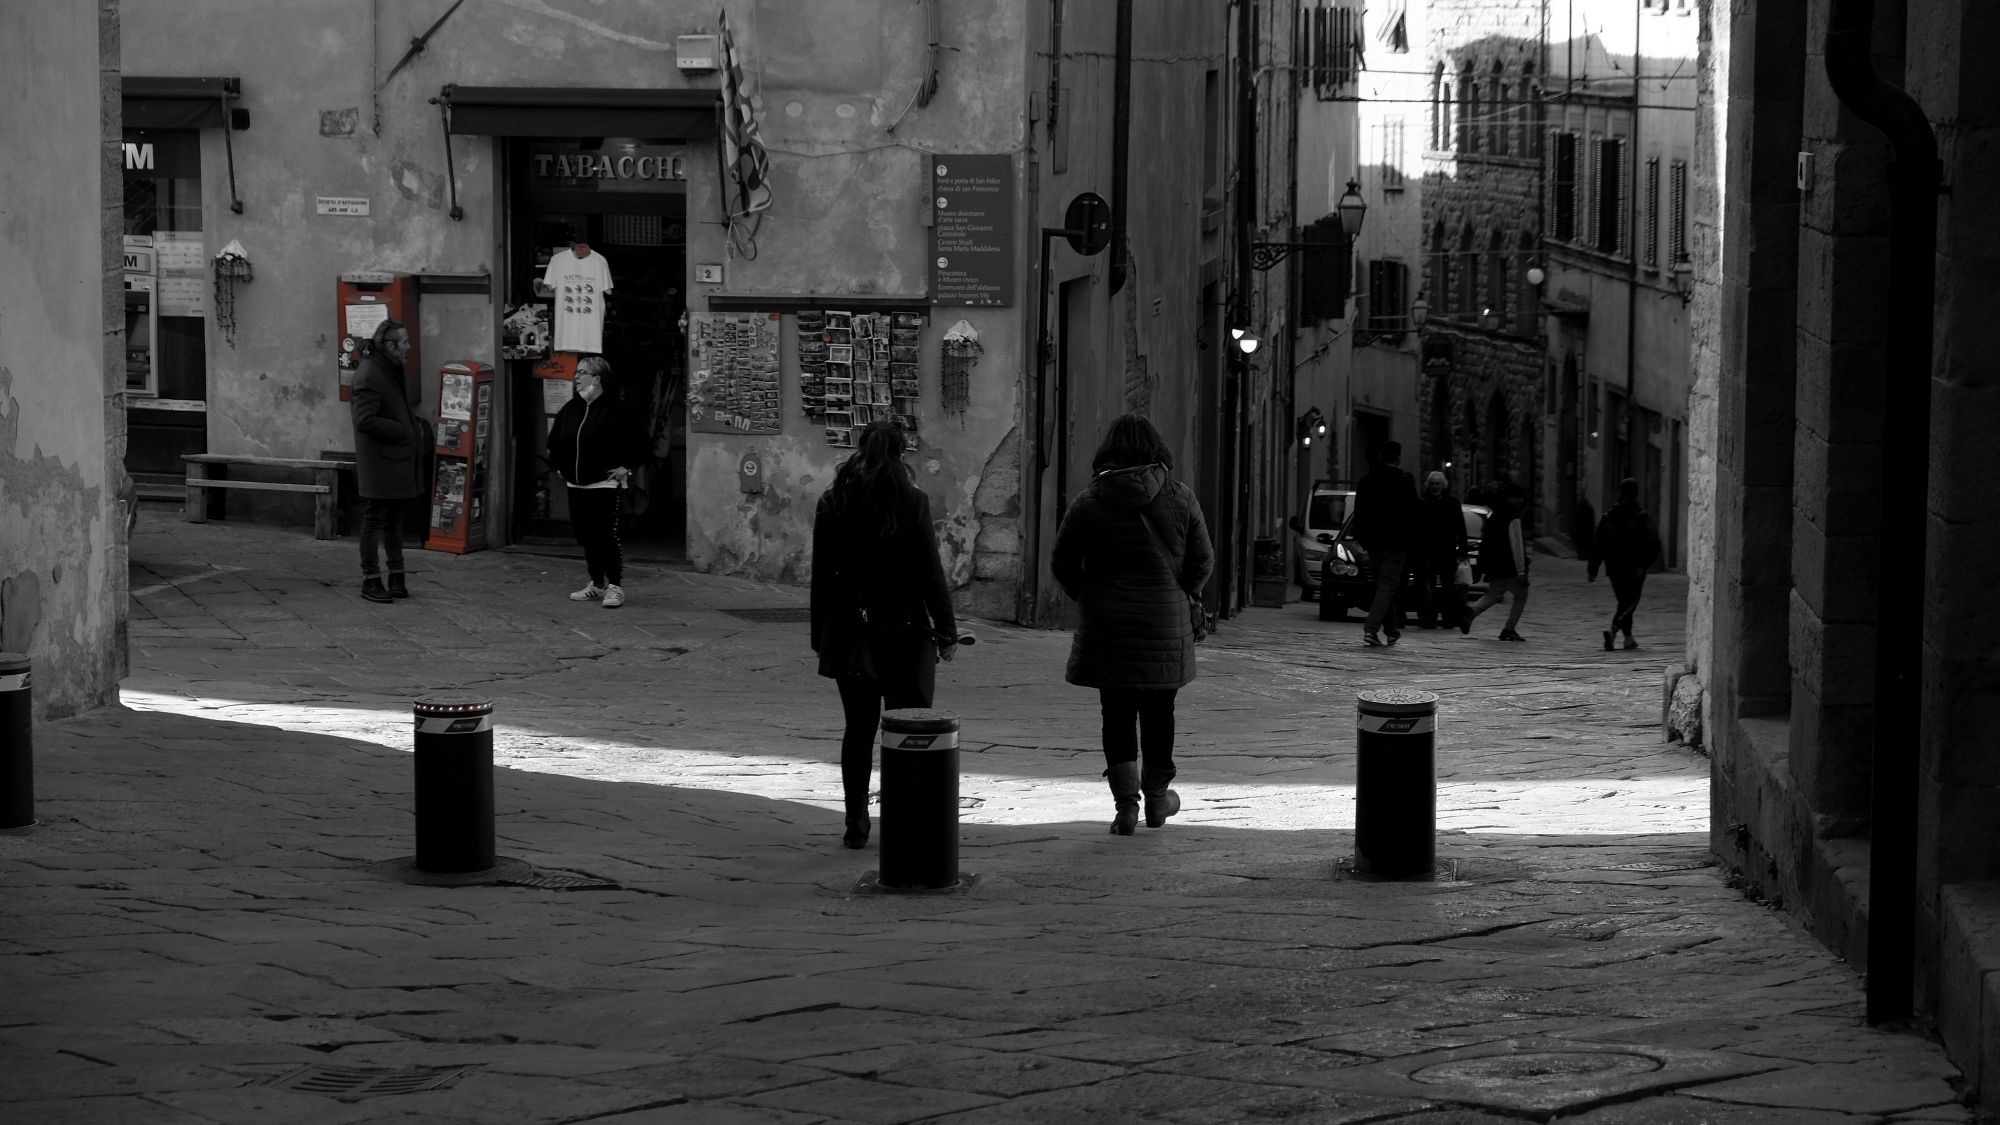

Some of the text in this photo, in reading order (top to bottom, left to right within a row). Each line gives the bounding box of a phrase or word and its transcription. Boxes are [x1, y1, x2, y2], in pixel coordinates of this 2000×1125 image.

[122, 143, 154, 169] M
[534, 154, 687, 180] TABACCHI
[921, 162, 931, 213] VOLTERRA
[705, 270, 712, 278] 2
